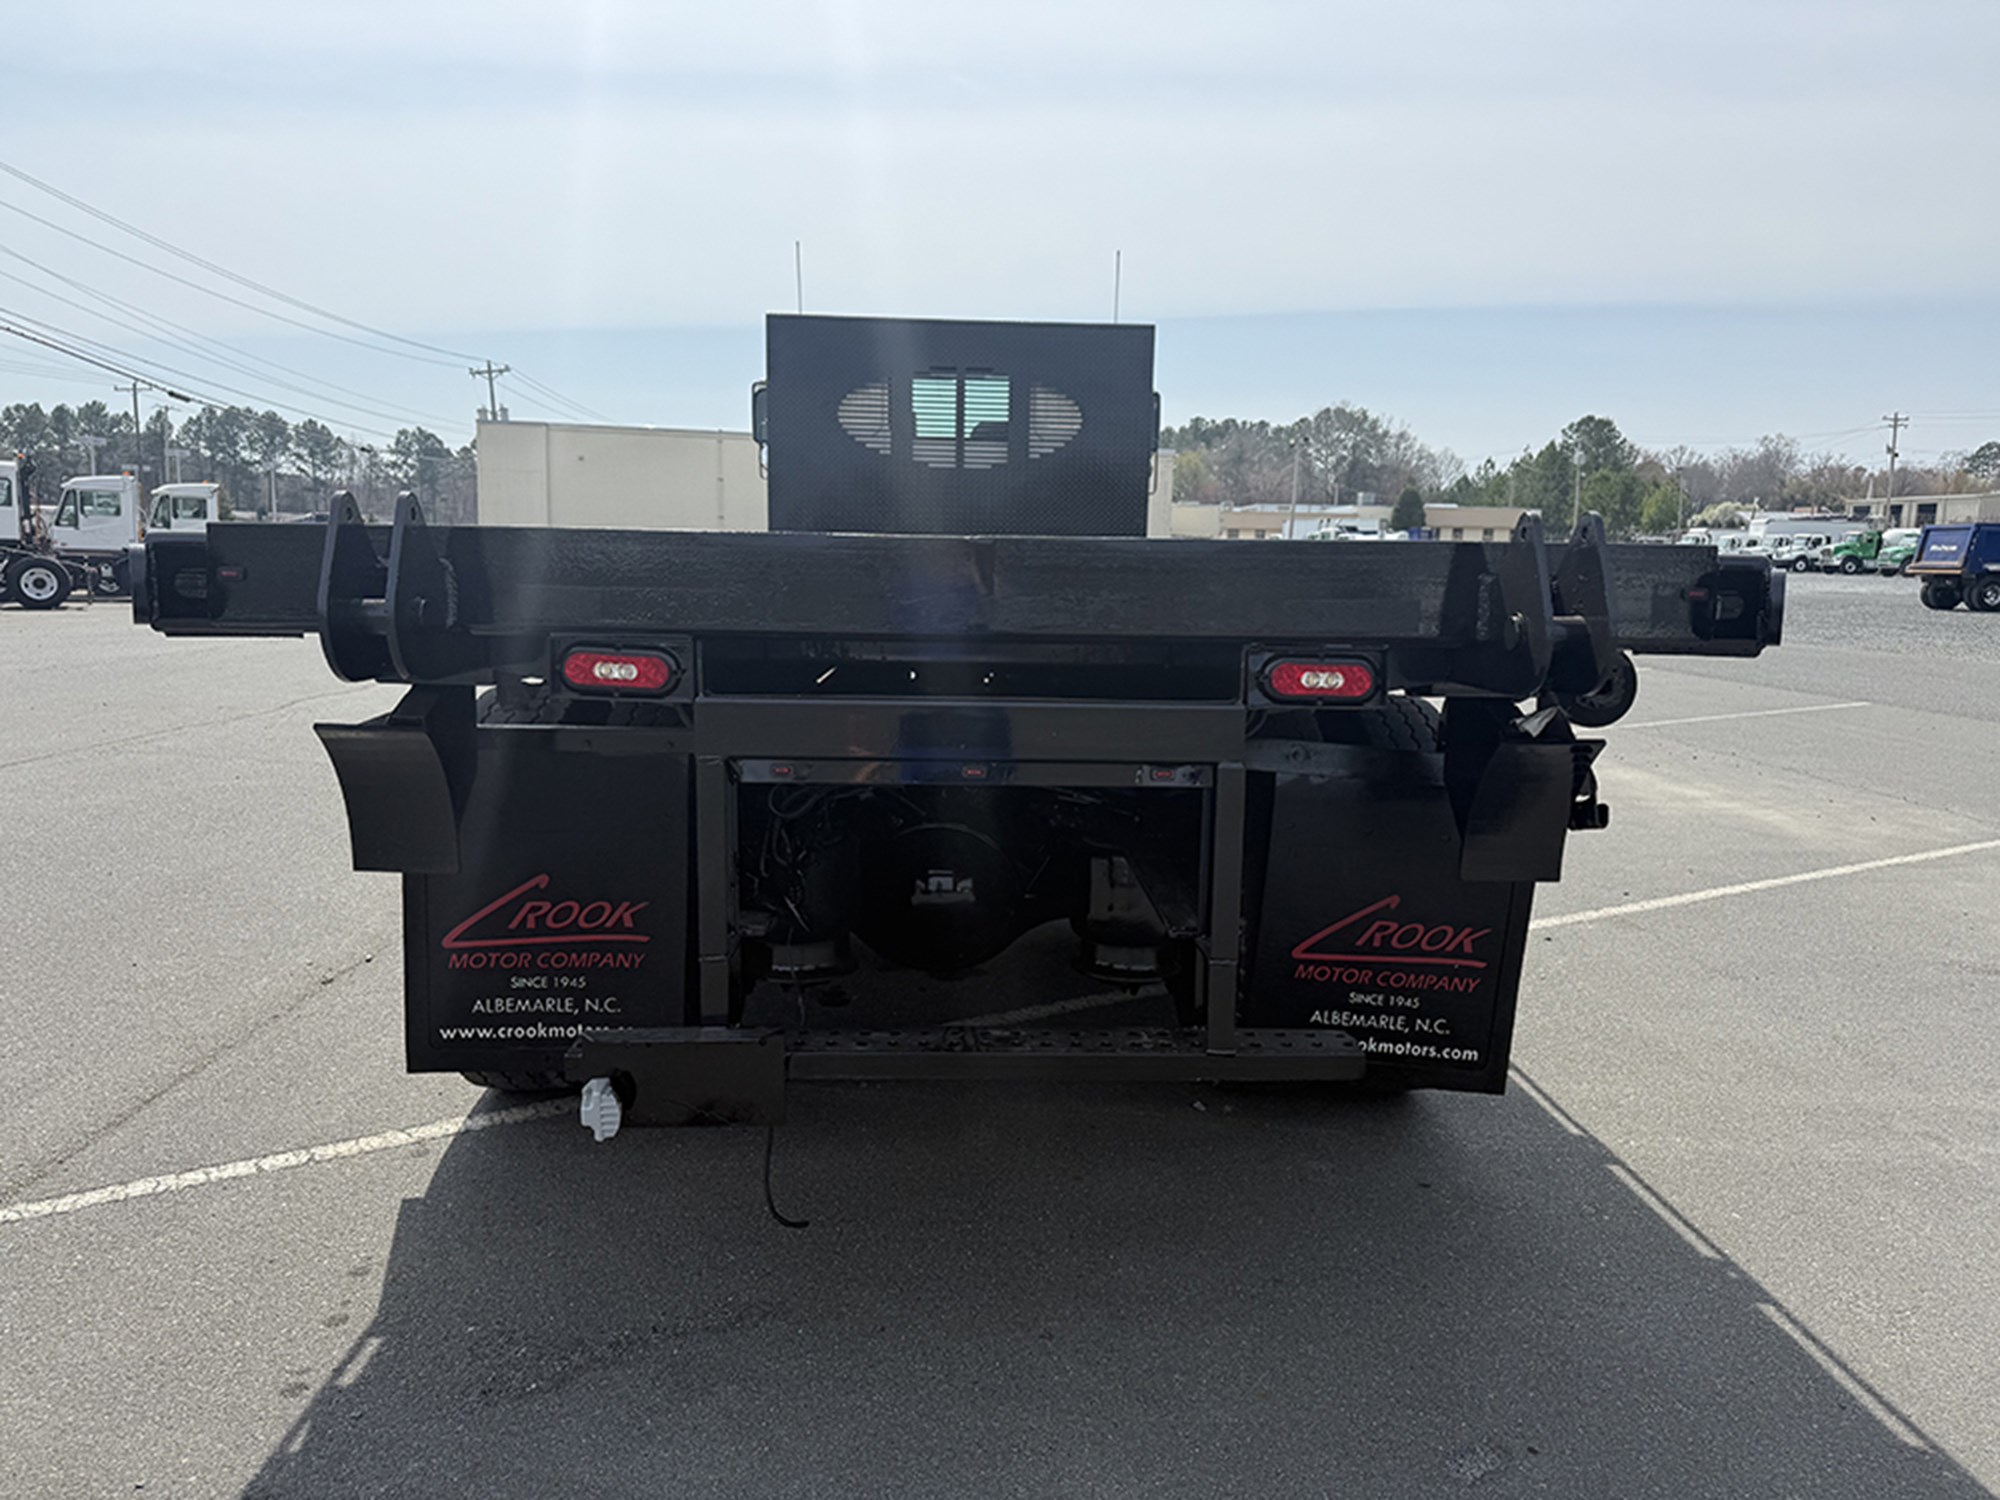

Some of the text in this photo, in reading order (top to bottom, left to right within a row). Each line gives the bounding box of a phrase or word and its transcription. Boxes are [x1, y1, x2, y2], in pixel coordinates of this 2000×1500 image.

[448, 952, 646, 969] MOTOR COMPANY
[510, 976, 587, 989] SINCE 1945
[1294, 964, 1481, 993] MOTOR COMPANY
[472, 998, 622, 1016] ALBEMARLE, N.C.
[1348, 991, 1421, 1009] SINCE 1945
[1309, 1010, 1451, 1035] ALBEMARLE, N.C.
